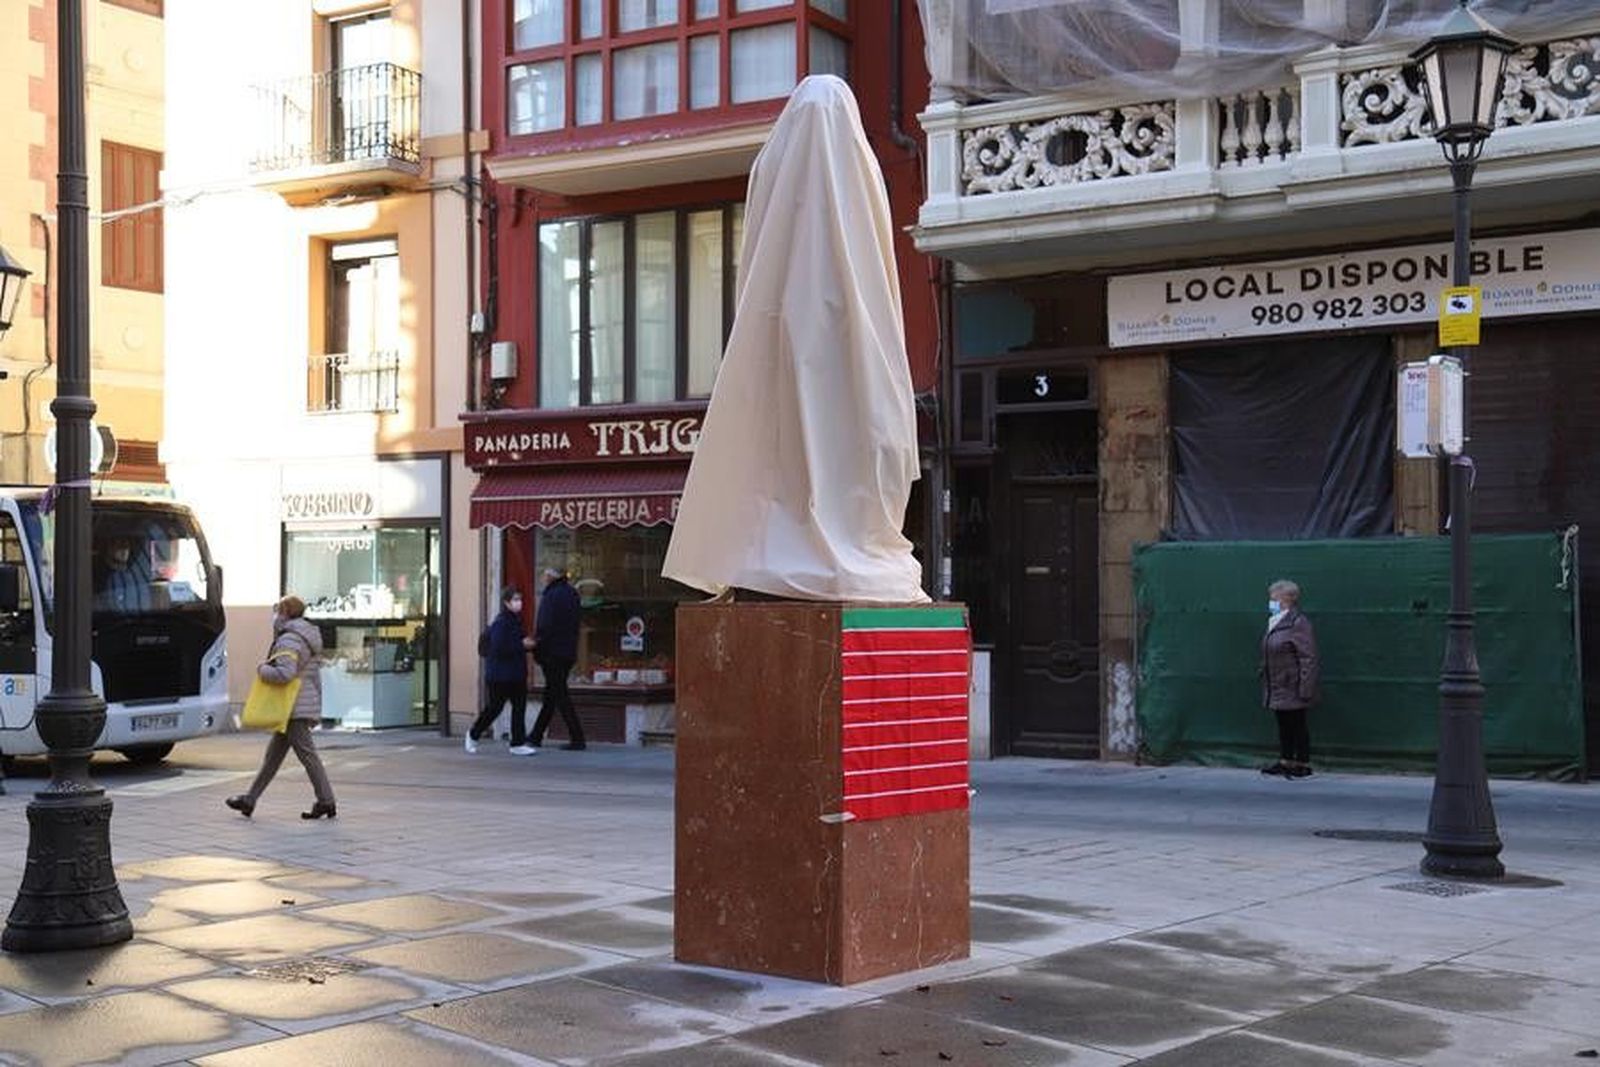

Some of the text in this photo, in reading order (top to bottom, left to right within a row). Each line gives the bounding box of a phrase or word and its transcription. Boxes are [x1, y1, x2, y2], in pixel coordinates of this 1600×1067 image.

[1165, 245, 1544, 304] LOCAL DISPONBLE
[1251, 291, 1426, 326] 980 982 303
[1035, 376, 1049, 396] 3
[474, 432, 572, 453] PANADERIA
[540, 498, 651, 522] PASTELERIA
